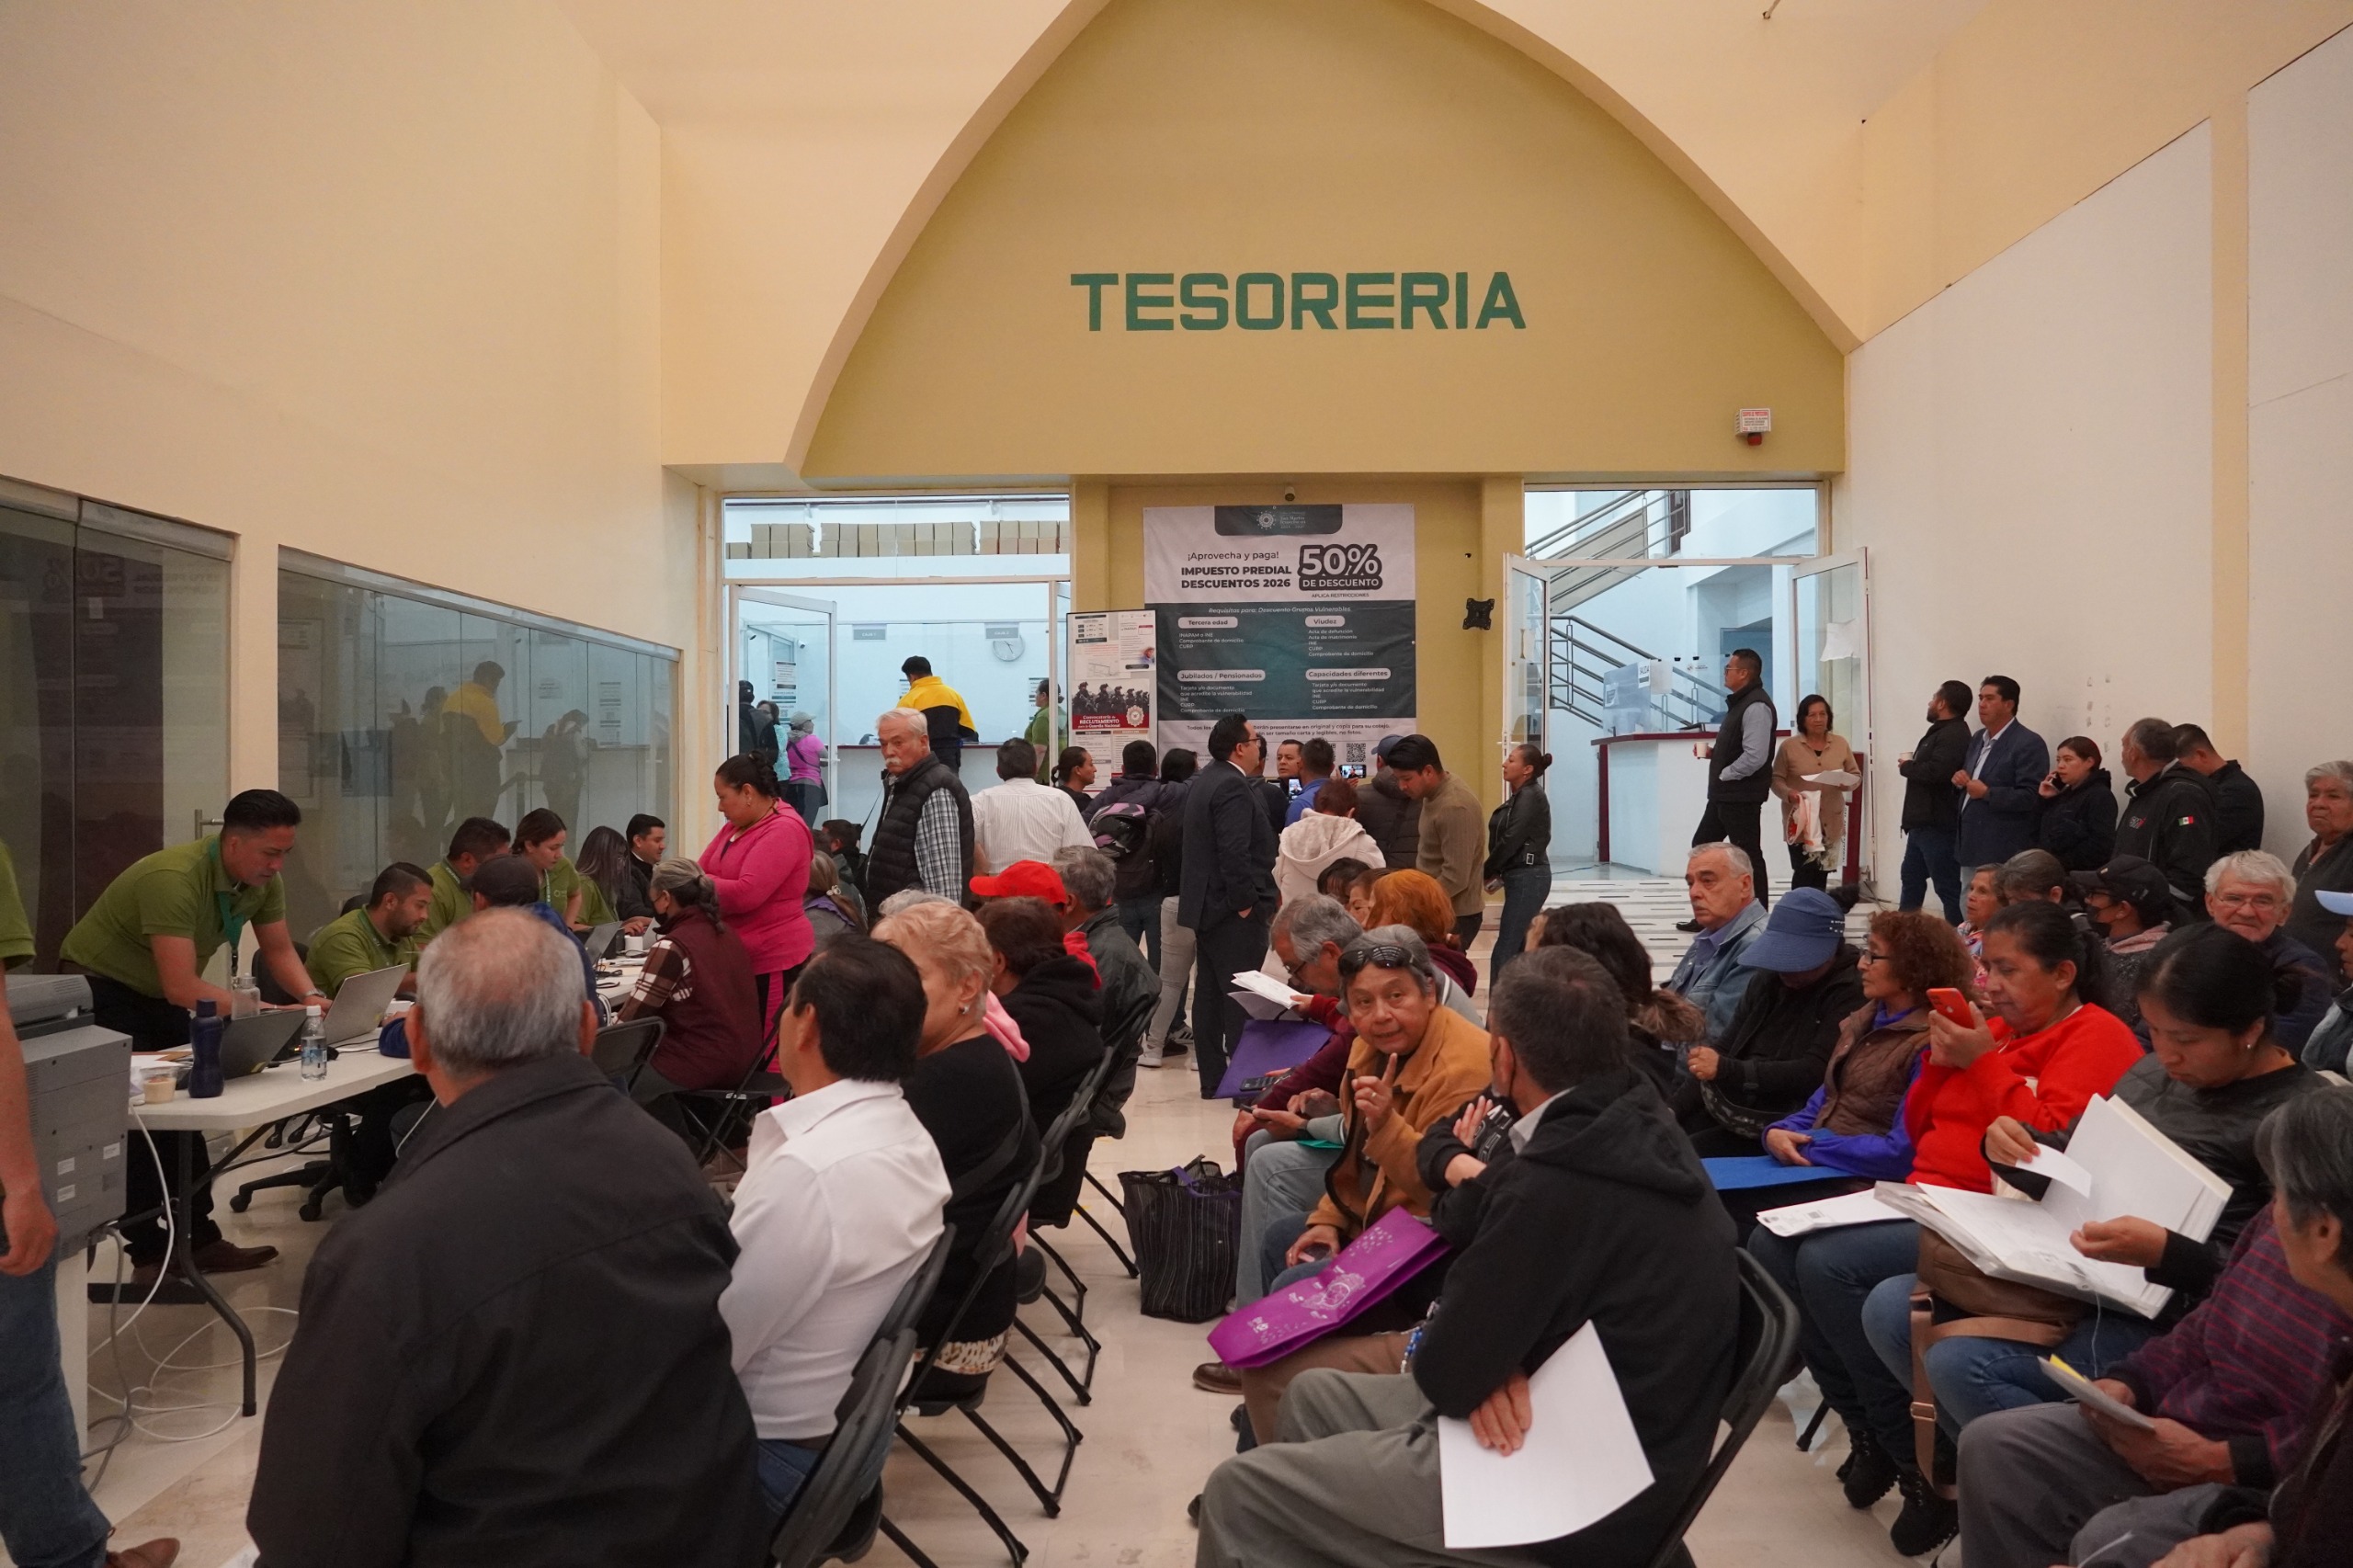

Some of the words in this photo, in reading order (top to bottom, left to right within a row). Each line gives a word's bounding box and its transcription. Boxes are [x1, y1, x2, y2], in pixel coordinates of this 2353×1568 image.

[1070, 271, 1527, 332] TESORERIA
[1188, 551, 1242, 562] ¡Aprovecha
[1244, 552, 1250, 561] y
[1252, 551, 1279, 561] paga!
[1300, 547, 1379, 575] 50%
[1181, 566, 1240, 575] IMPUESTO
[1243, 566, 1291, 574] PREDIAL
[1181, 579, 1260, 588] DESCUENTOS
[1263, 578, 1290, 587] 2026
[1302, 579, 1316, 587] DE
[1319, 578, 1379, 587] DESCUENTO
